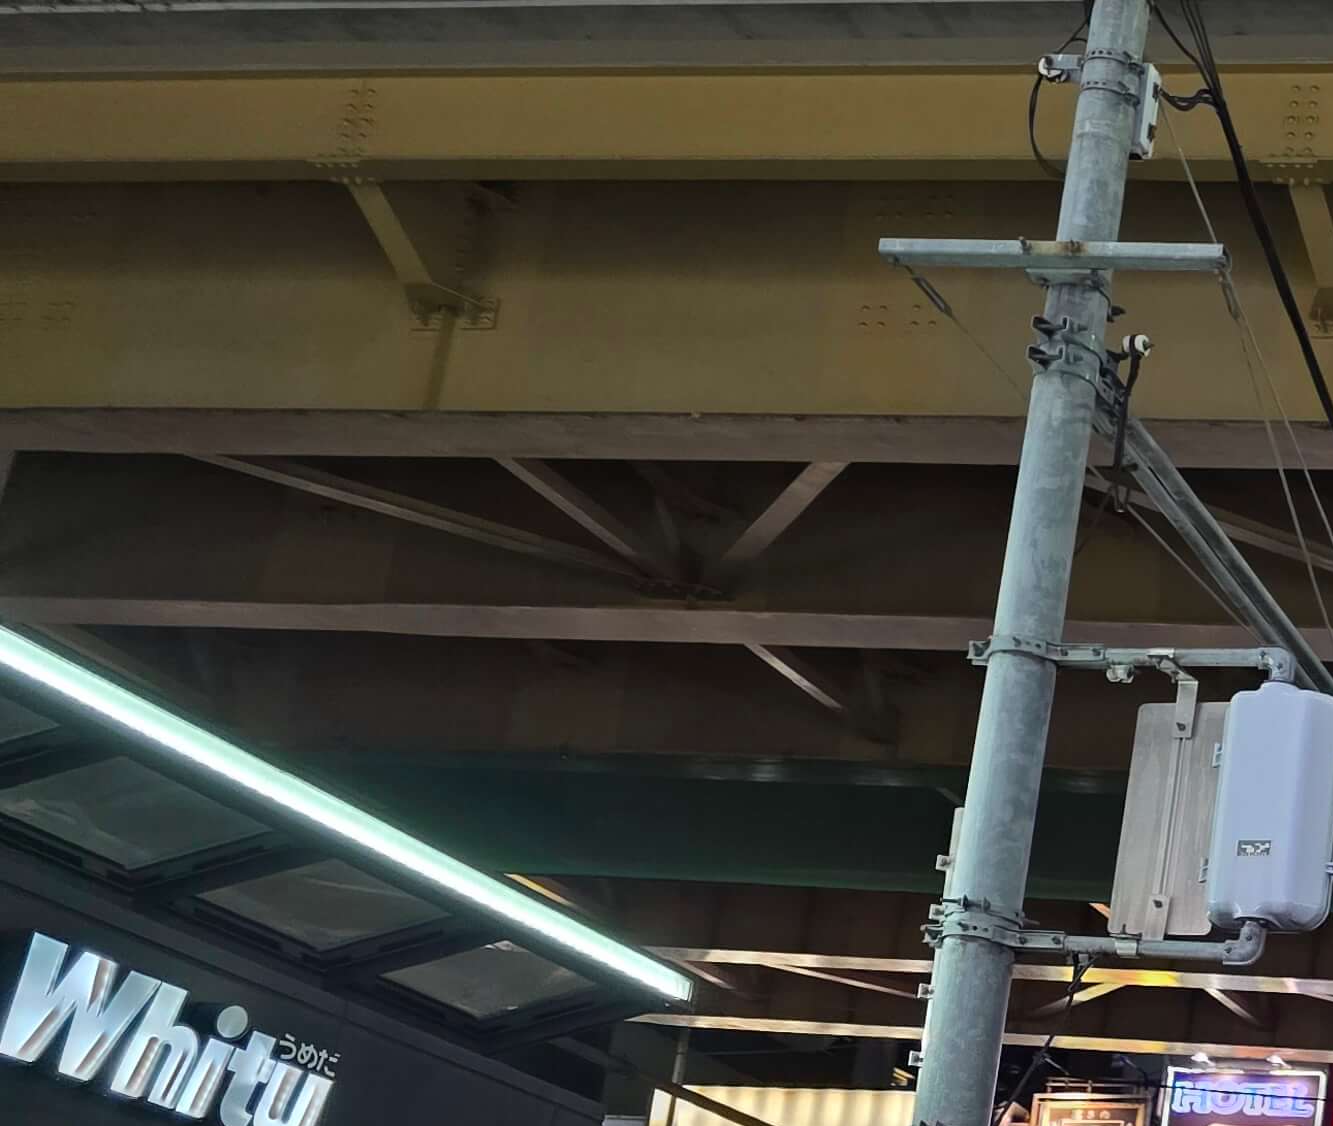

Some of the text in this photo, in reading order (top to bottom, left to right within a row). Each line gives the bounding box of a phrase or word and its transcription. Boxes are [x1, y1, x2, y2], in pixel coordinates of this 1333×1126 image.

[279, 1033, 341, 1077] うめだ
[1171, 1080, 1314, 1118] HOTEL
